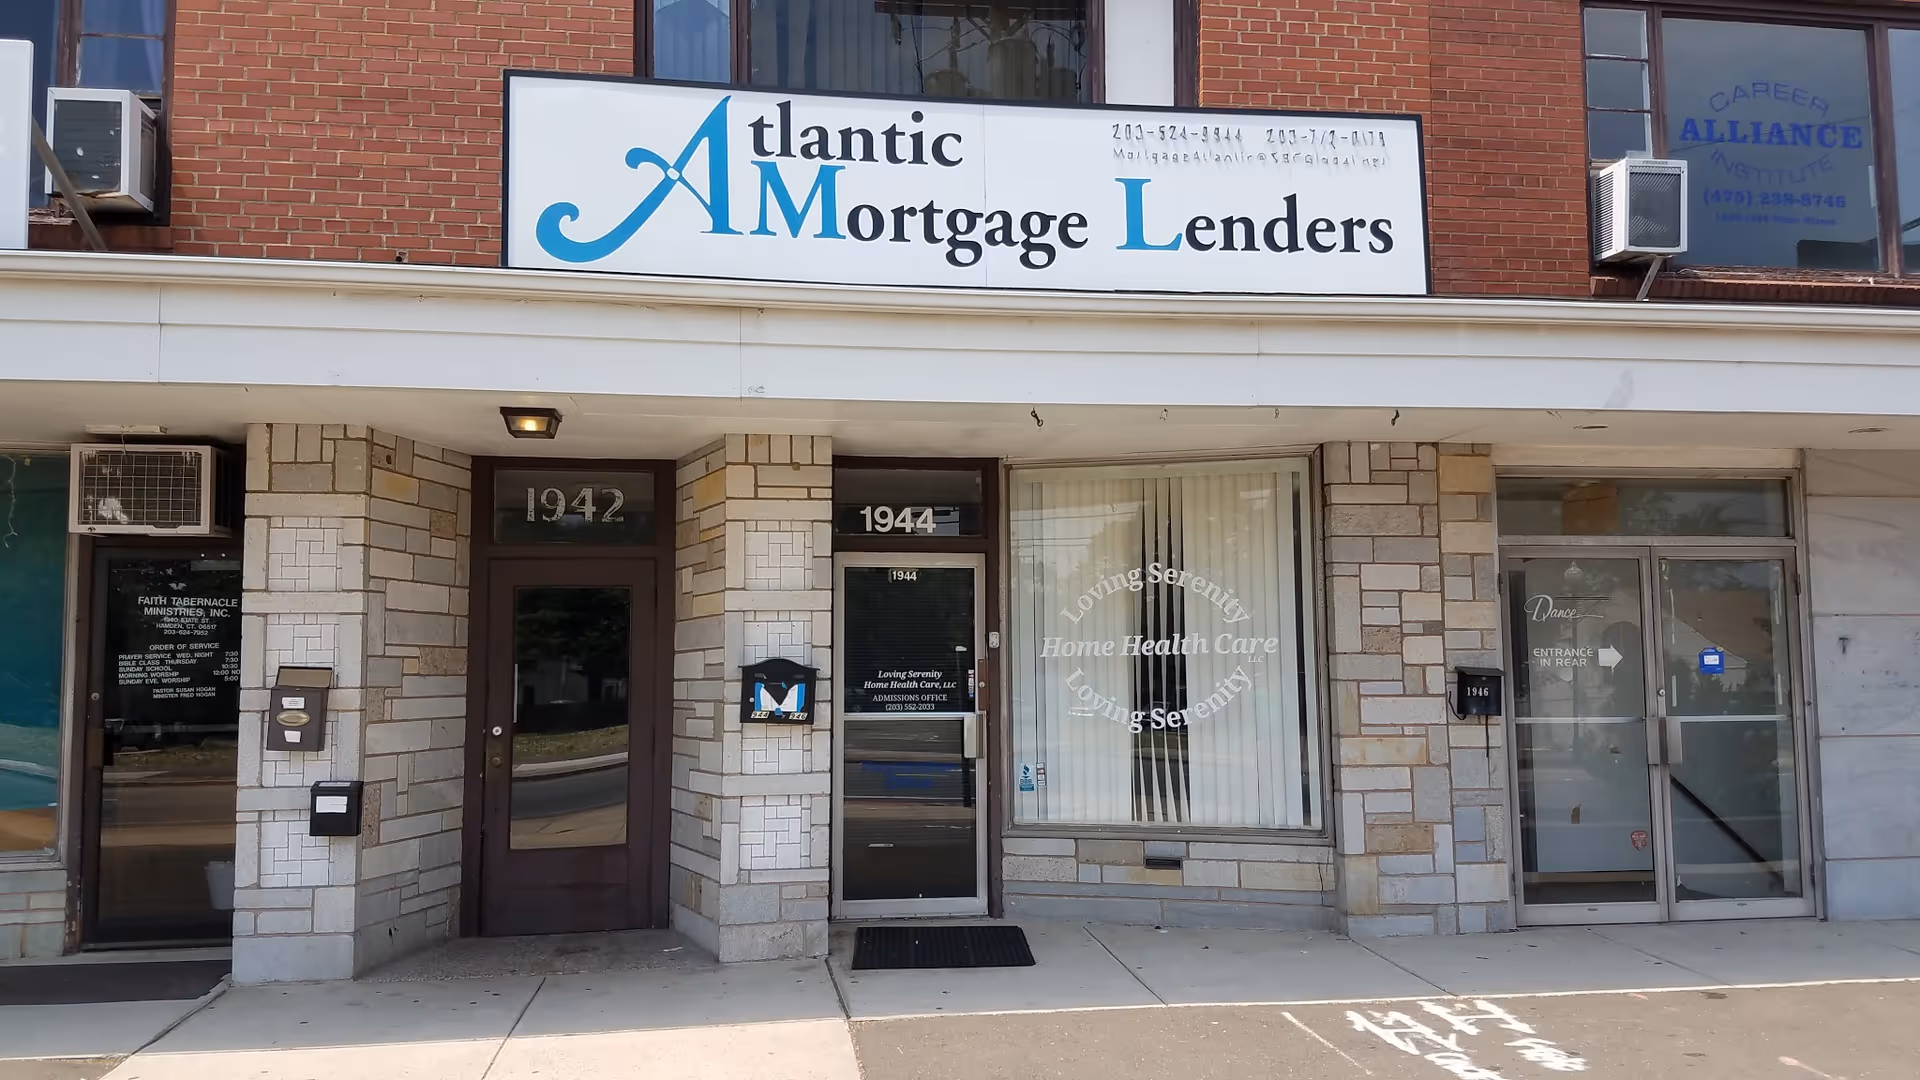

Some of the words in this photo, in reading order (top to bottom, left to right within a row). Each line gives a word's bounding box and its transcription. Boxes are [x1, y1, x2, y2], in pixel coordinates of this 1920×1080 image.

[1709, 82, 1829, 117] CAREER
[1679, 117, 1863, 149] ALLIANCE
[1710, 148, 1833, 185] INSTITUTE
[536, 95, 963, 264] Atlantic
[749, 160, 1088, 270] Mortgage
[1115, 177, 1394, 254] Lenders
[526, 486, 625, 523] 1942
[860, 505, 937, 534] 1944
[892, 571, 918, 581] 1944
[1060, 567, 1144, 625] Loving
[1148, 562, 1250, 623] Serenity
[137, 596, 167, 605] FAITH
[170, 597, 238, 607] TABERNACLE
[144, 607, 206, 617] MINISTRIES,
[209, 608, 231, 618] INC.
[1523, 594, 1590, 622] Dance
[176, 643, 187, 651] OF
[189, 642, 220, 650] SERVICE
[1040, 636, 1115, 658] Home
[1119, 633, 1209, 656] Health
[1214, 633, 1278, 655] Care
[1533, 648, 1594, 657] ENTRANCE
[1247, 655, 1264, 663] LLC
[1540, 659, 1551, 667] IN
[1556, 659, 1587, 667] REAR
[877, 670, 907, 680] Loving
[907, 670, 942, 680] Serenity
[864, 680, 889, 689] Home
[889, 680, 919, 689] Health
[919, 680, 942, 690] Care,
[943, 681, 957, 689] LLC
[1466, 686, 1489, 697] 1946
[873, 694, 920, 702] ADMISSIONS
[921, 694, 948, 702] OFFICE
[1064, 667, 1145, 733] Loving
[1150, 665, 1252, 730] Serenity
[885, 703, 903, 711] (203)
[903, 703, 935, 711] 552-2033
